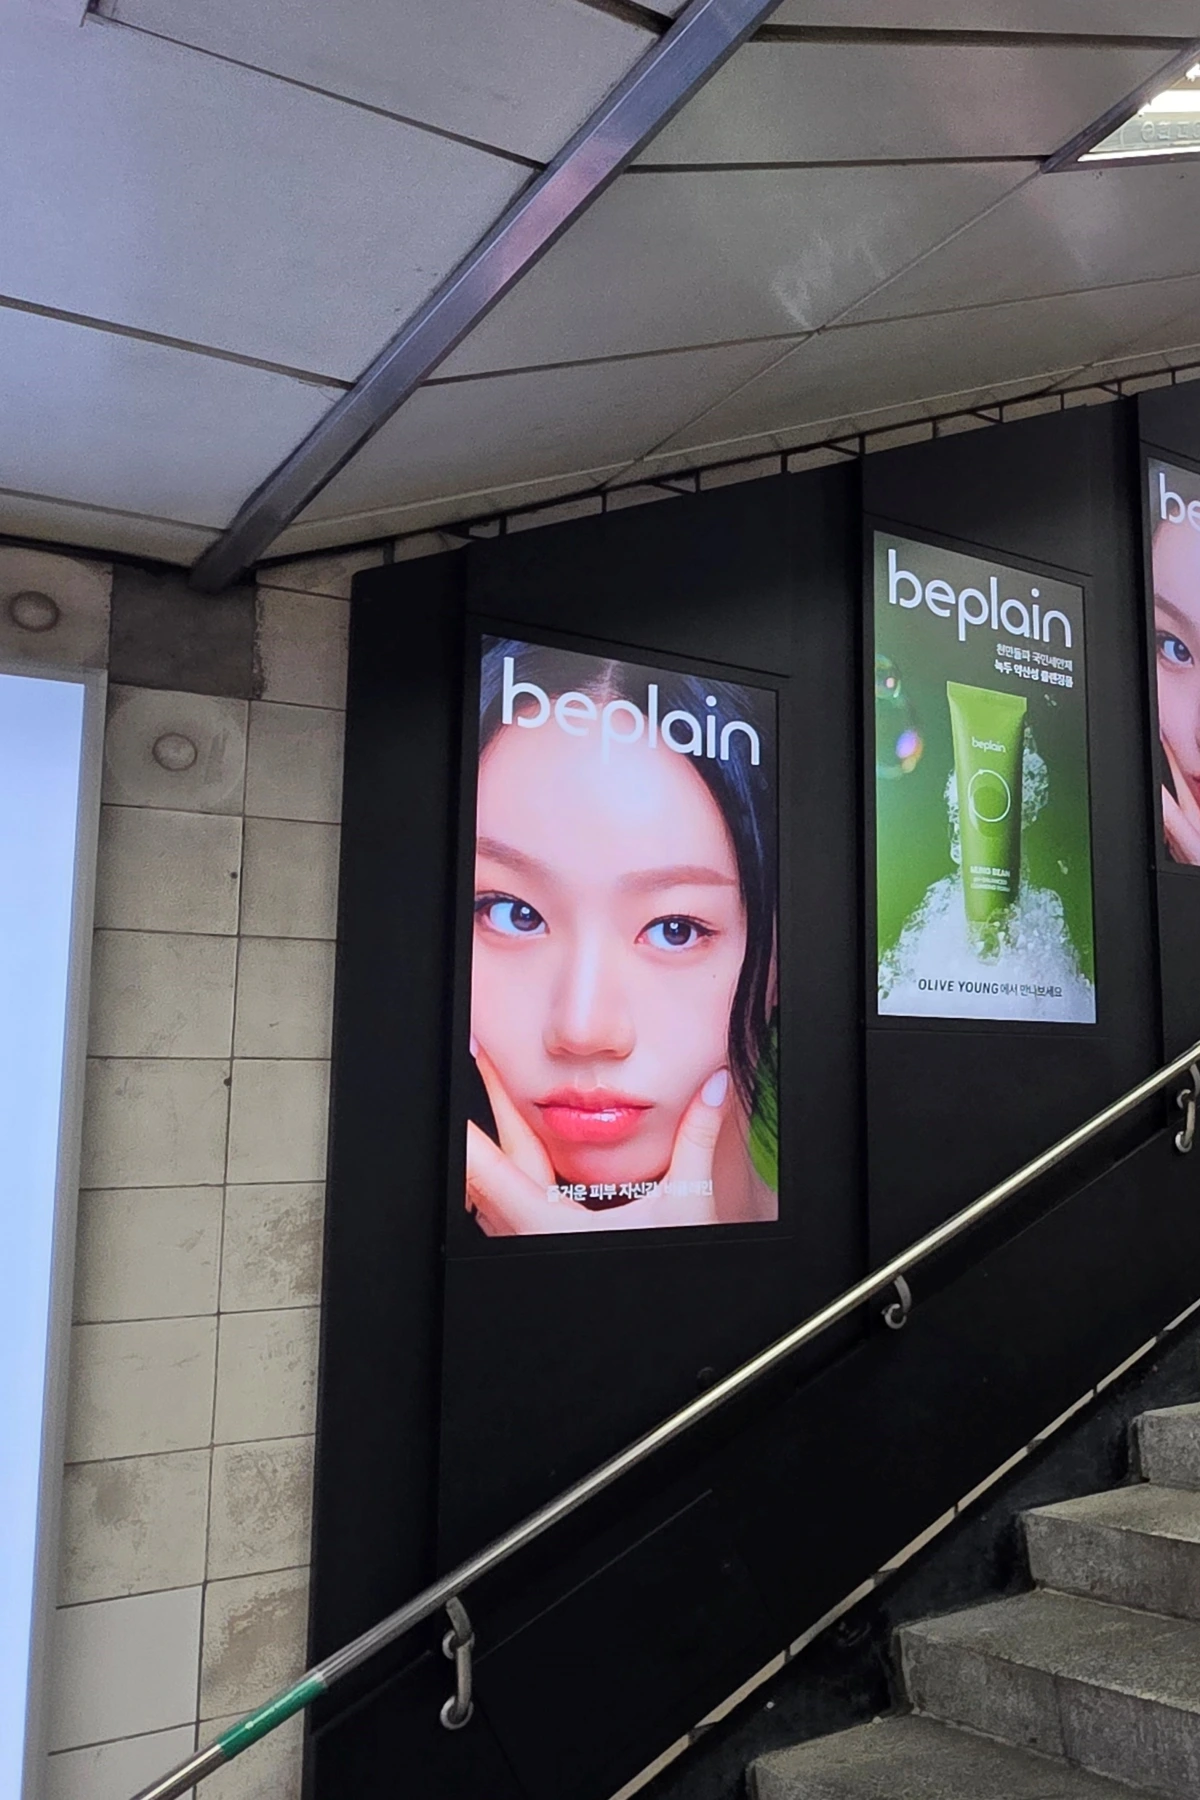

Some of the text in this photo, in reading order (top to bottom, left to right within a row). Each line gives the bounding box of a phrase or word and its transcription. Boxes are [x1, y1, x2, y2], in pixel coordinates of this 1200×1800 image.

[887, 548, 1072, 648] beplain
[502, 656, 760, 766] beplain
[918, 978, 955, 992] OLIVE
[589, 1183, 617, 1201] 피부
